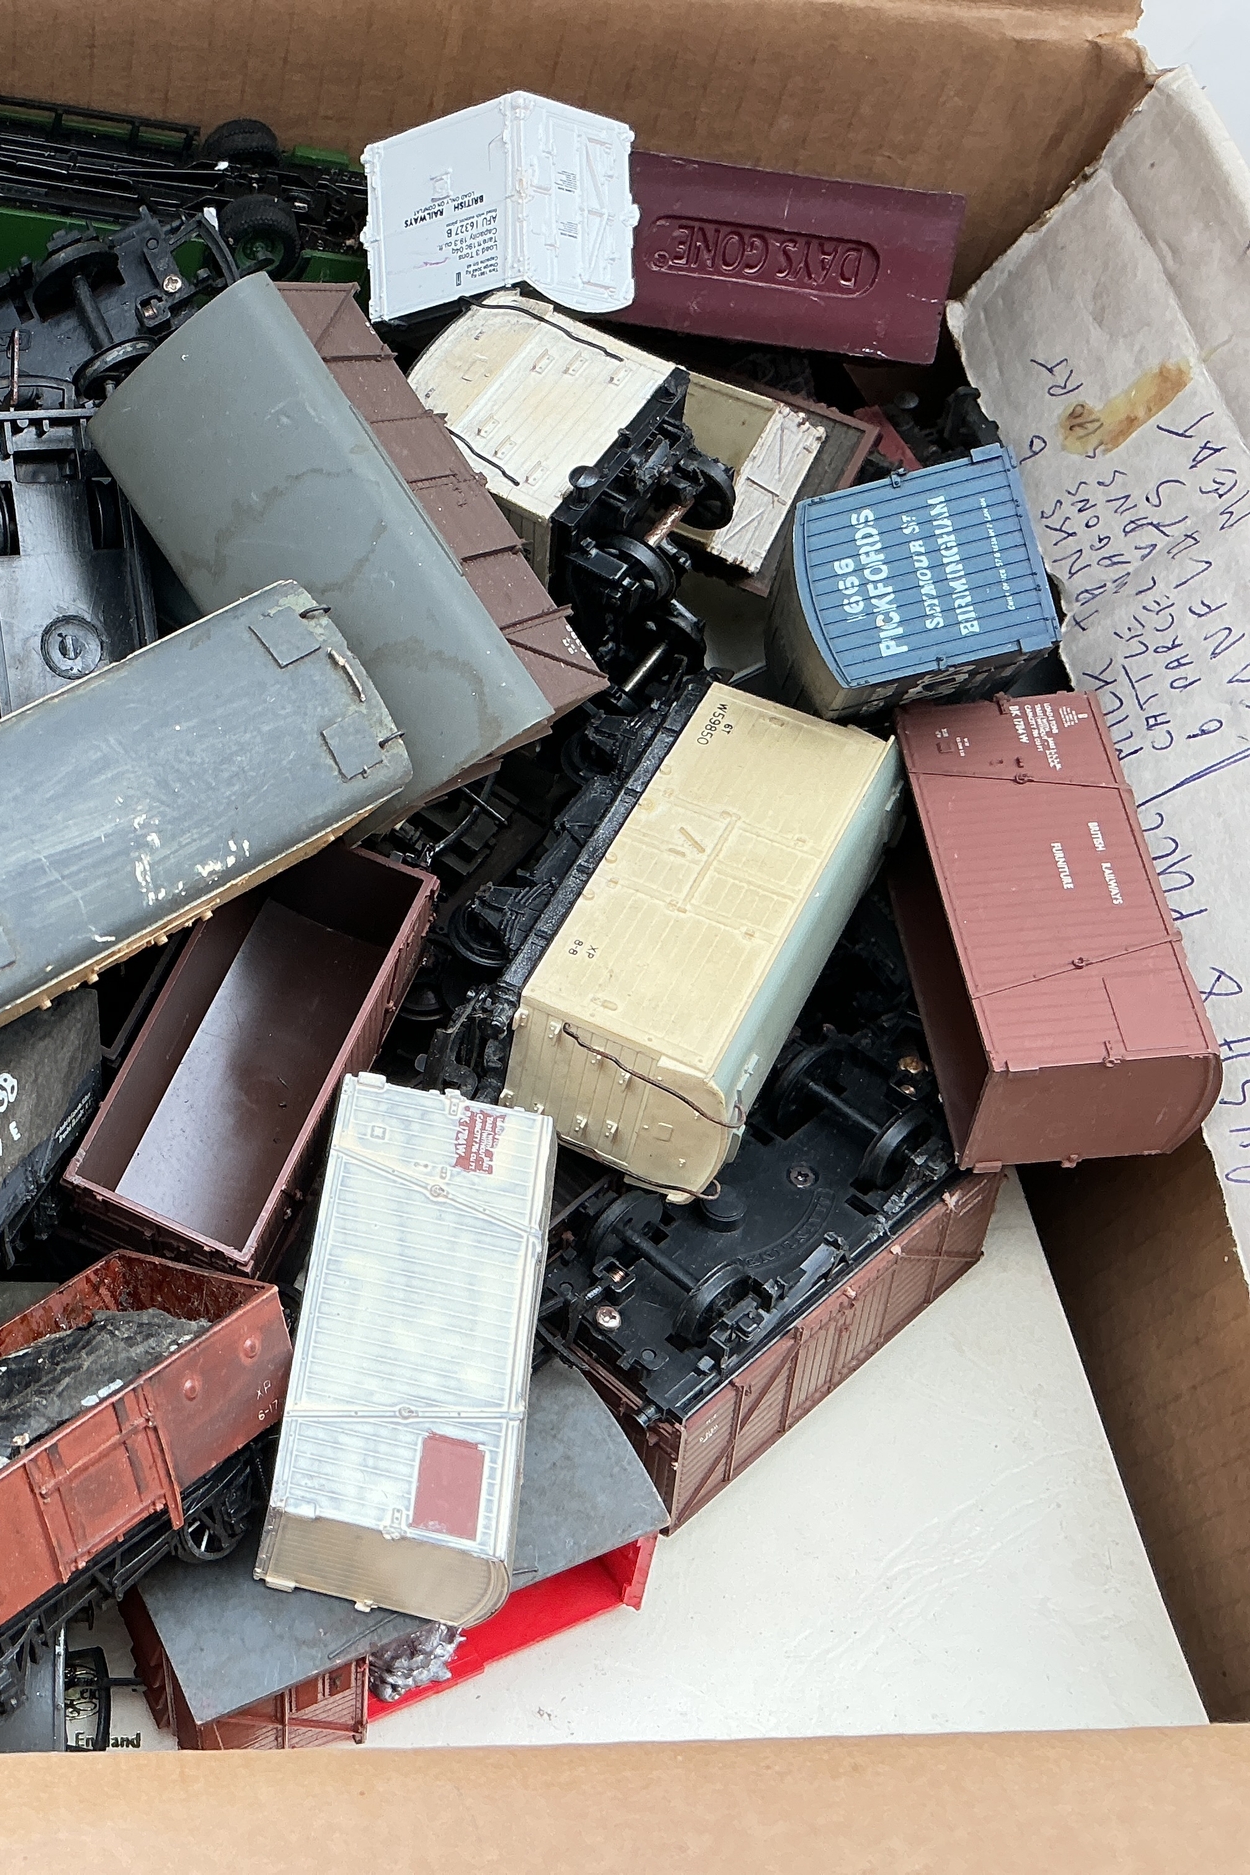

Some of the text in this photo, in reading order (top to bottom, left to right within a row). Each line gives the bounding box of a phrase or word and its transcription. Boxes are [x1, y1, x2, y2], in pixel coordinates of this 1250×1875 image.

[403, 194, 484, 229] BRITISH RAILWAYS
[446, 213, 498, 238] AFU 16327 B
[470, 227, 498, 241] Capacity
[482, 236, 498, 245] Tare
[482, 243, 498, 254] Load
[458, 251, 474, 260] Tons
[775, 239, 864, 289] DAYS
[1096, 469, 1158, 562] VANS
[851, 508, 909, 658] PICKFORDS
[908, 539, 945, 630] SEYMOUR
[926, 495, 980, 637] BIRMINGHAM
[1039, 499, 1108, 632] TANKS
[1136, 575, 1202, 693] PARCEL
[696, 702, 729, 746] W59850
[1008, 705, 1022, 717] BK
[1050, 842, 1075, 890] FURNITURE
[1087, 821, 1124, 905] BRITISH RAILWAYS
[586, 944, 599, 959] XP
[256, 1379, 271, 1400] XP
[74, 1731, 142, 1749] Enland
